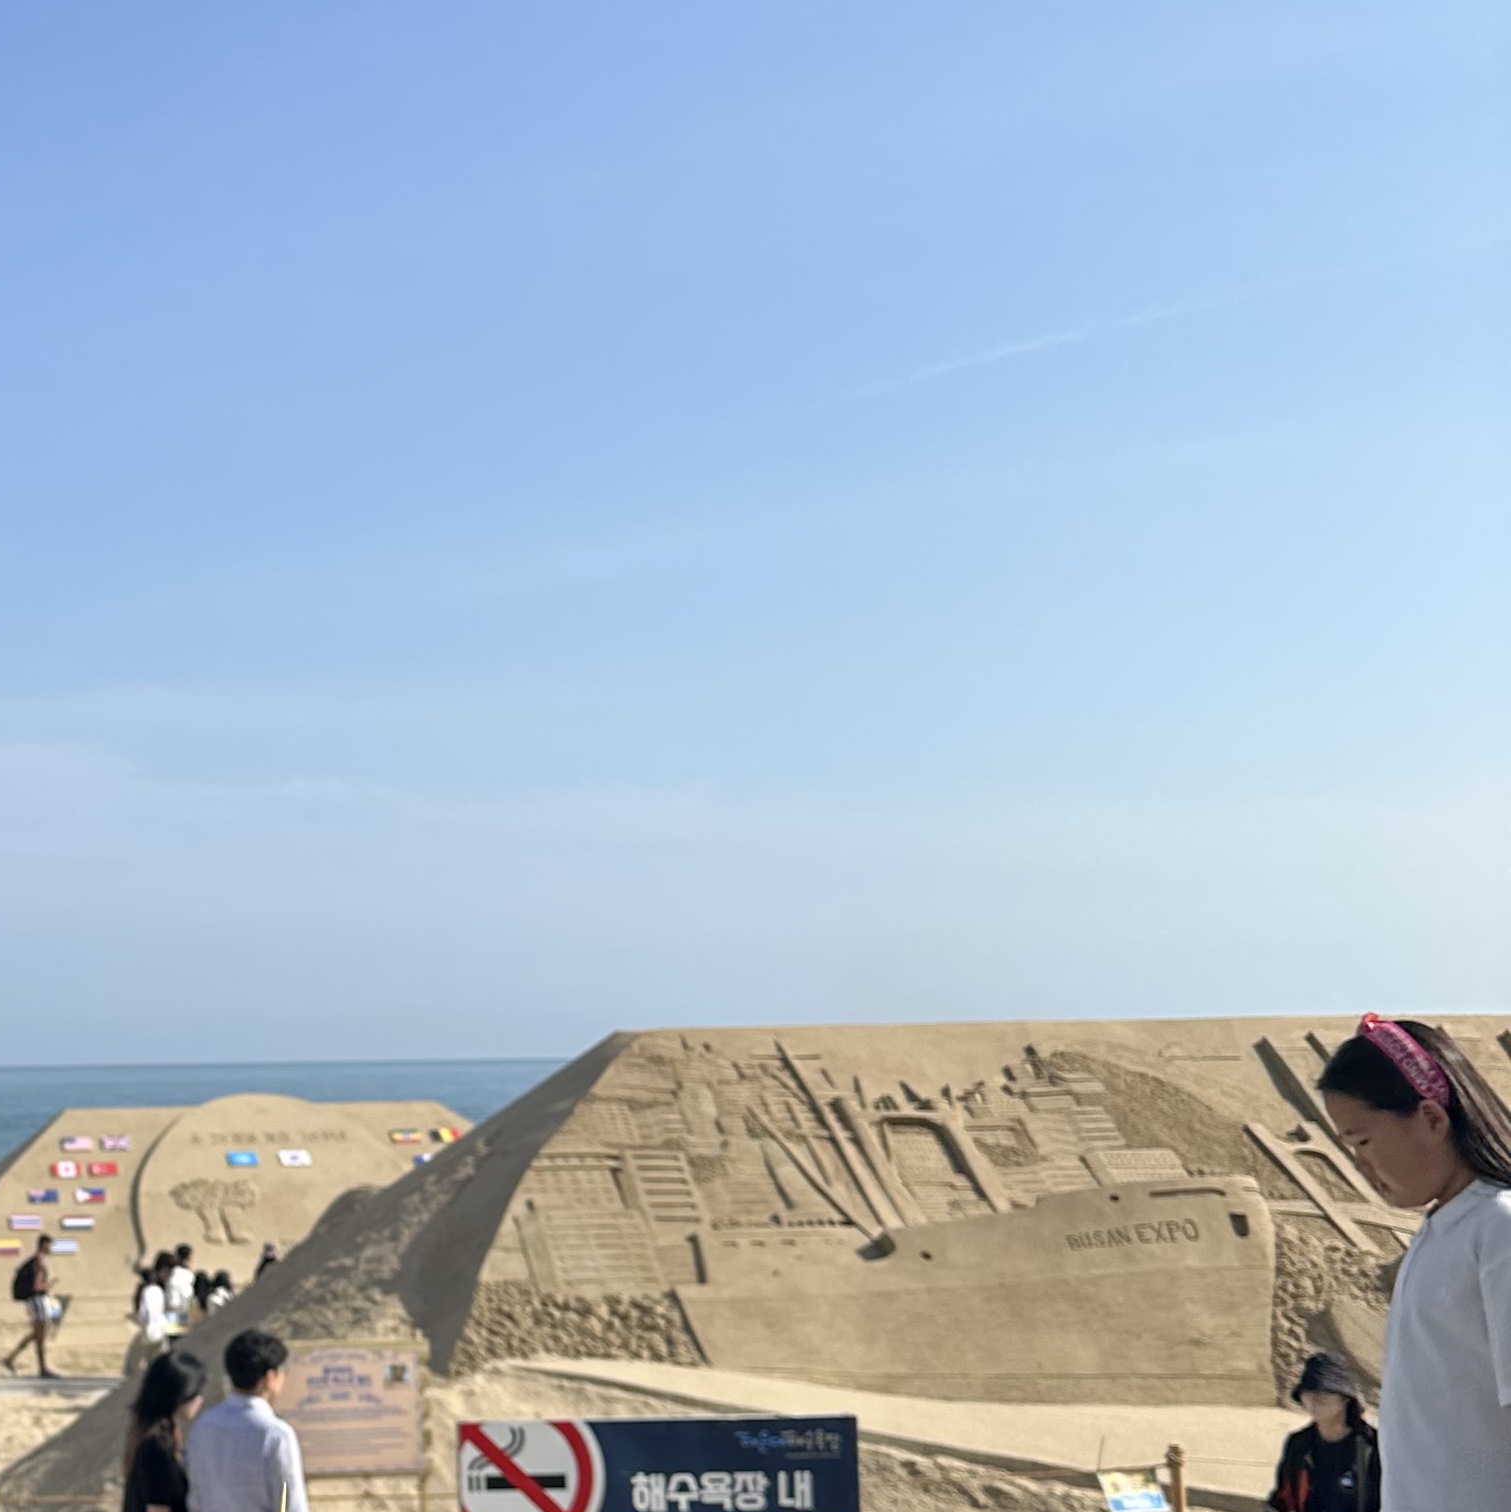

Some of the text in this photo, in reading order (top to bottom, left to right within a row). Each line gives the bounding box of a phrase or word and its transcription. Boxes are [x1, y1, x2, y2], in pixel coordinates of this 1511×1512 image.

[1065, 1218, 1200, 1251] BUSAN EXPO
[777, 1469, 815, 1512] 내
